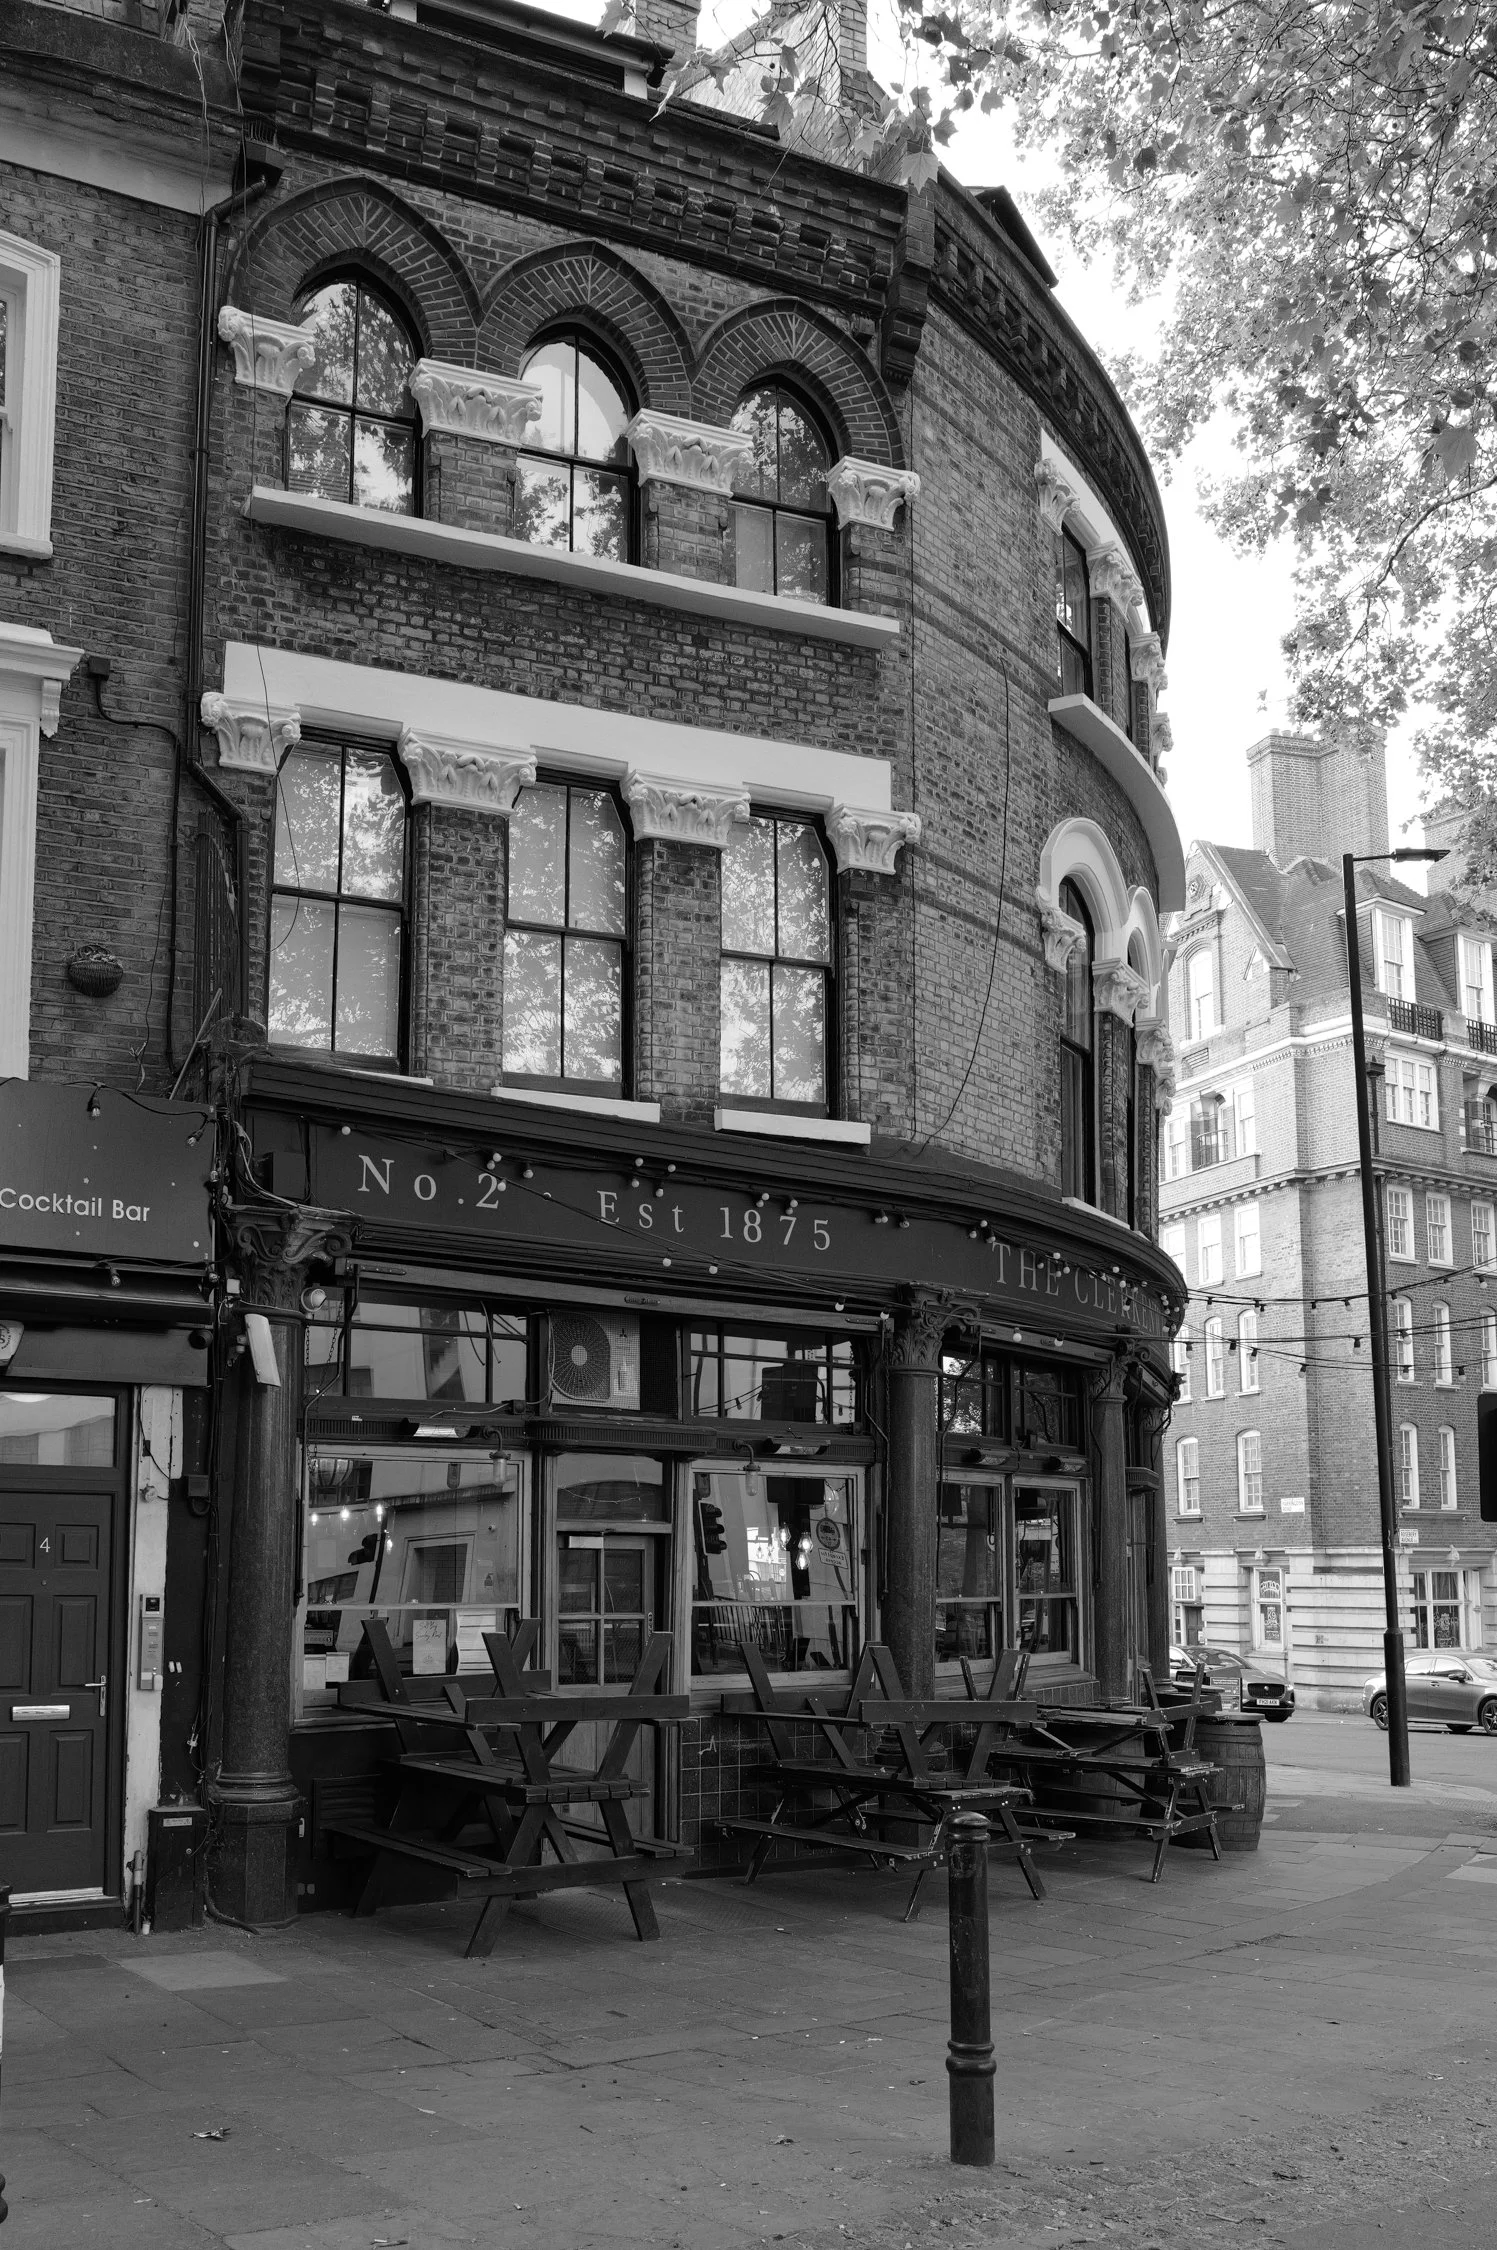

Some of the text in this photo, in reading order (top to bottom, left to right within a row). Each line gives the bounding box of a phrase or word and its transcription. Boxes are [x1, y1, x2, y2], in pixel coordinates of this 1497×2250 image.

[0, 1187, 152, 1223] Cocktail Bar
[356, 1154, 832, 1252] No.2 Est 1875
[991, 1241, 1060, 1297] THE
[39, 1536, 51, 1553] 4
